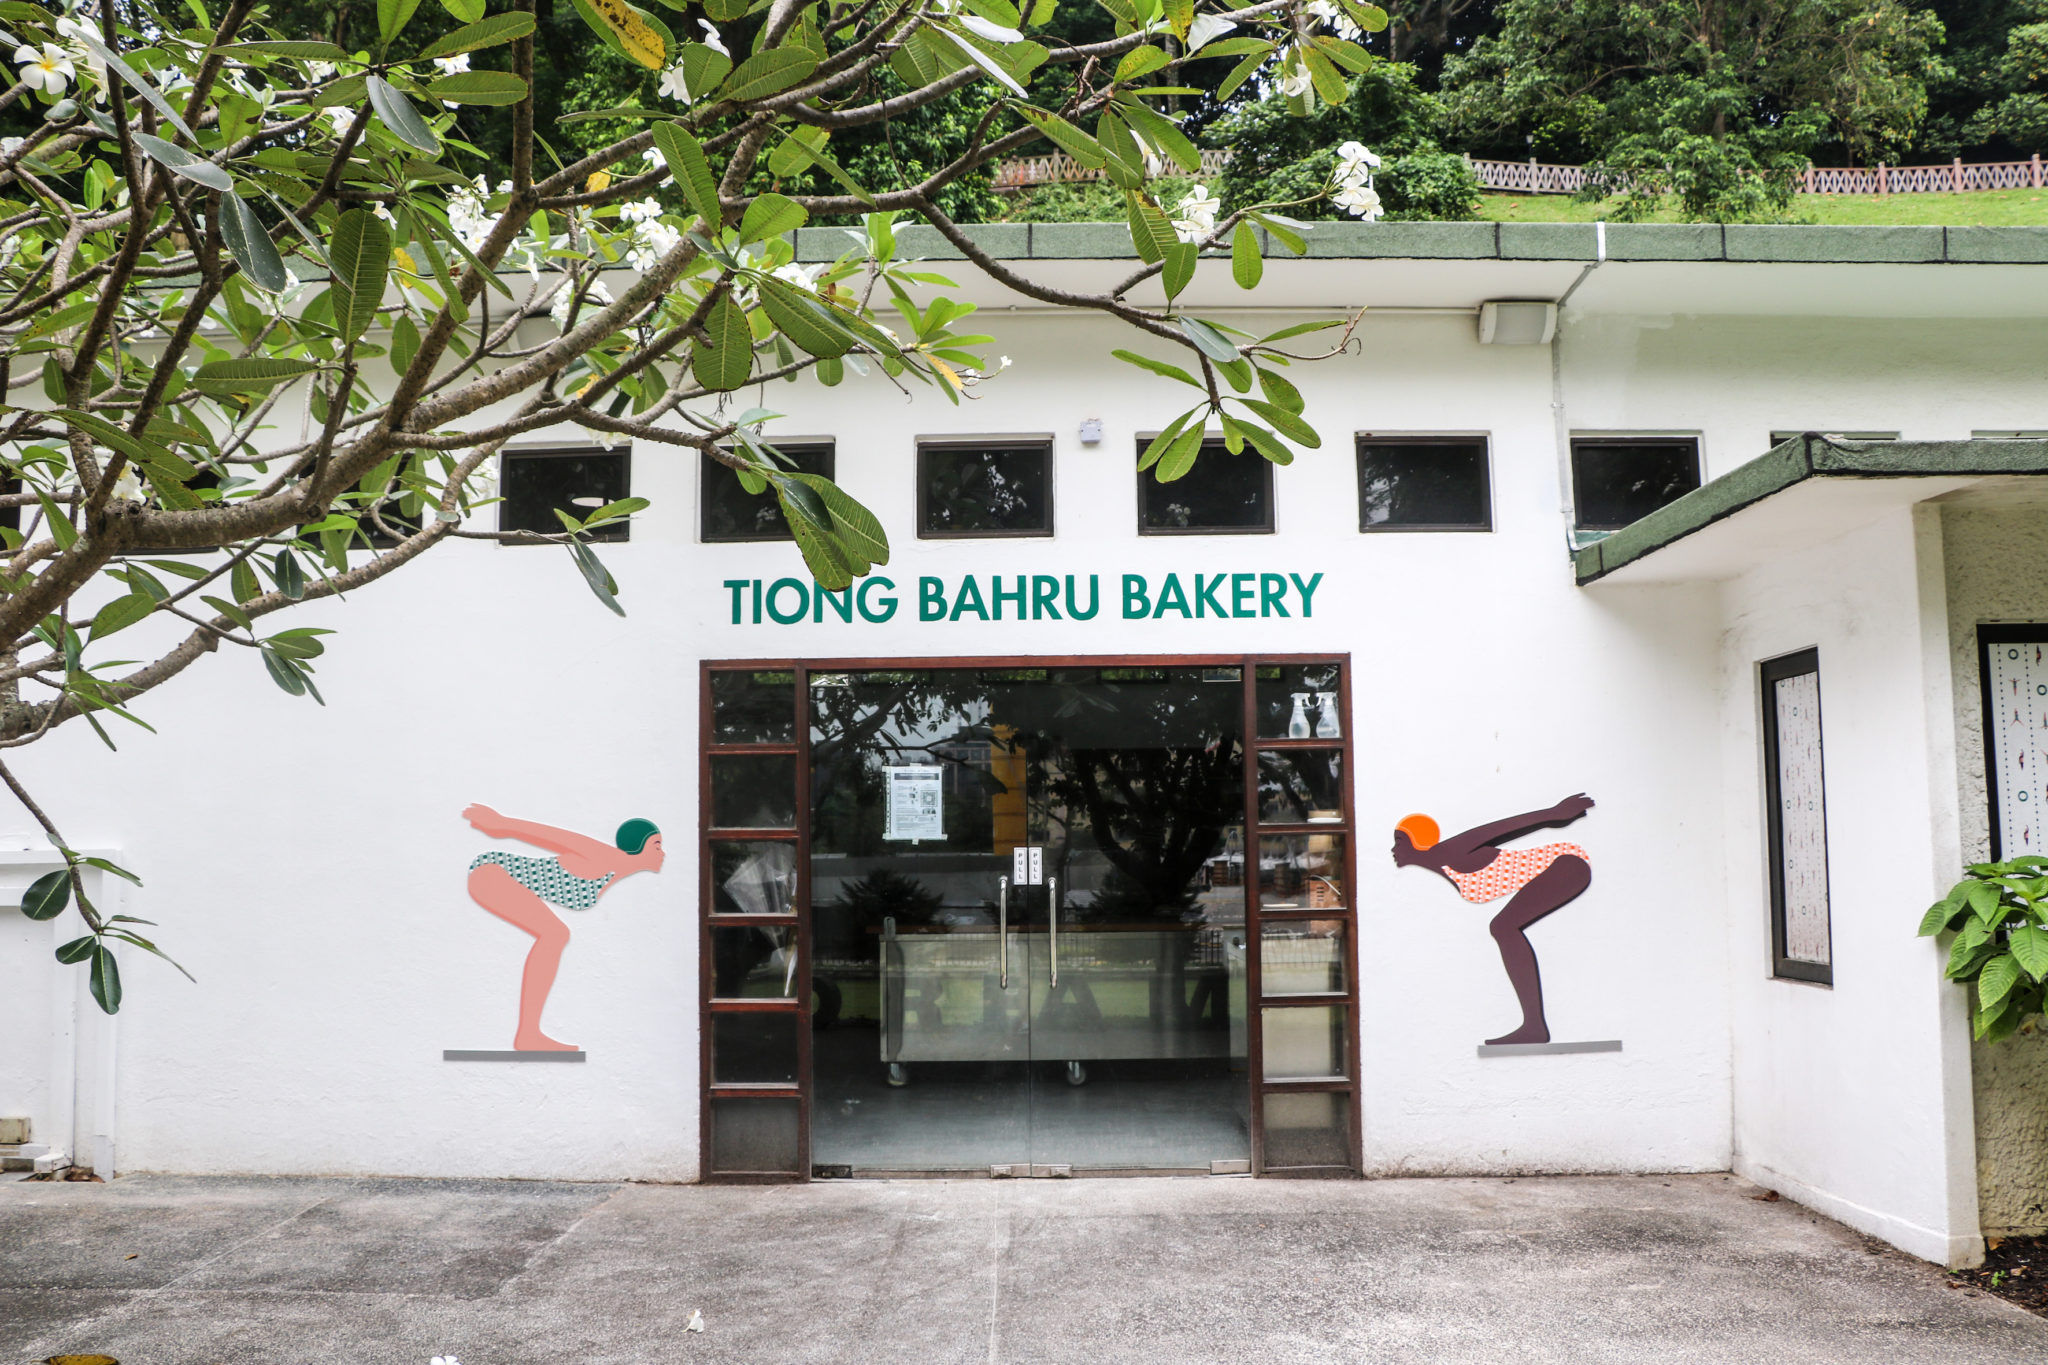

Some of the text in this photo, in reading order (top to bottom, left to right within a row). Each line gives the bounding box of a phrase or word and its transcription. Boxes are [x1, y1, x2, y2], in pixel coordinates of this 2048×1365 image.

[723, 572, 1324, 625] TIONG BAHRU BAKERY
